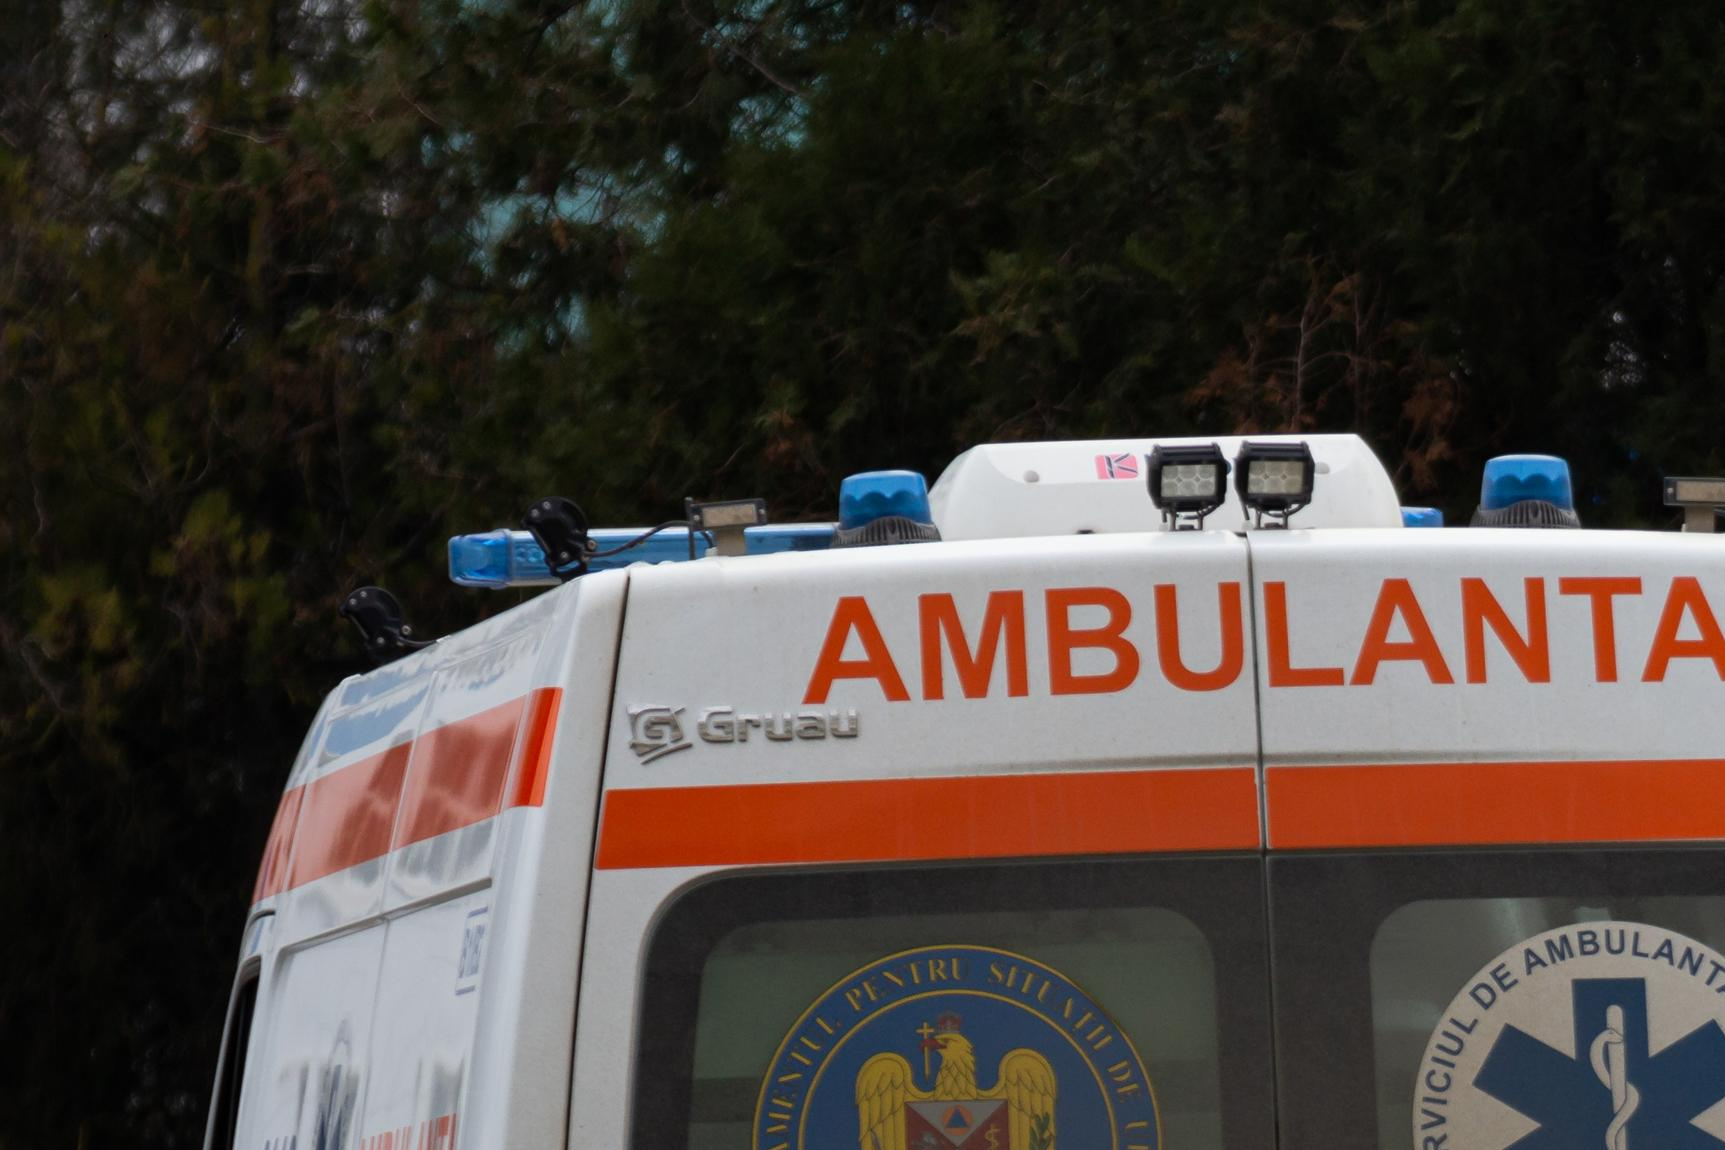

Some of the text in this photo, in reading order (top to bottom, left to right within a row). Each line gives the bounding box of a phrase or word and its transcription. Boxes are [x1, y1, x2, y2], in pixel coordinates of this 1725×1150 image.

[697, 704, 859, 743] Gruau
[1468, 962, 1519, 1011] DE
[845, 957, 972, 1013] PENTRU
[1107, 1060, 1143, 1105] DE
